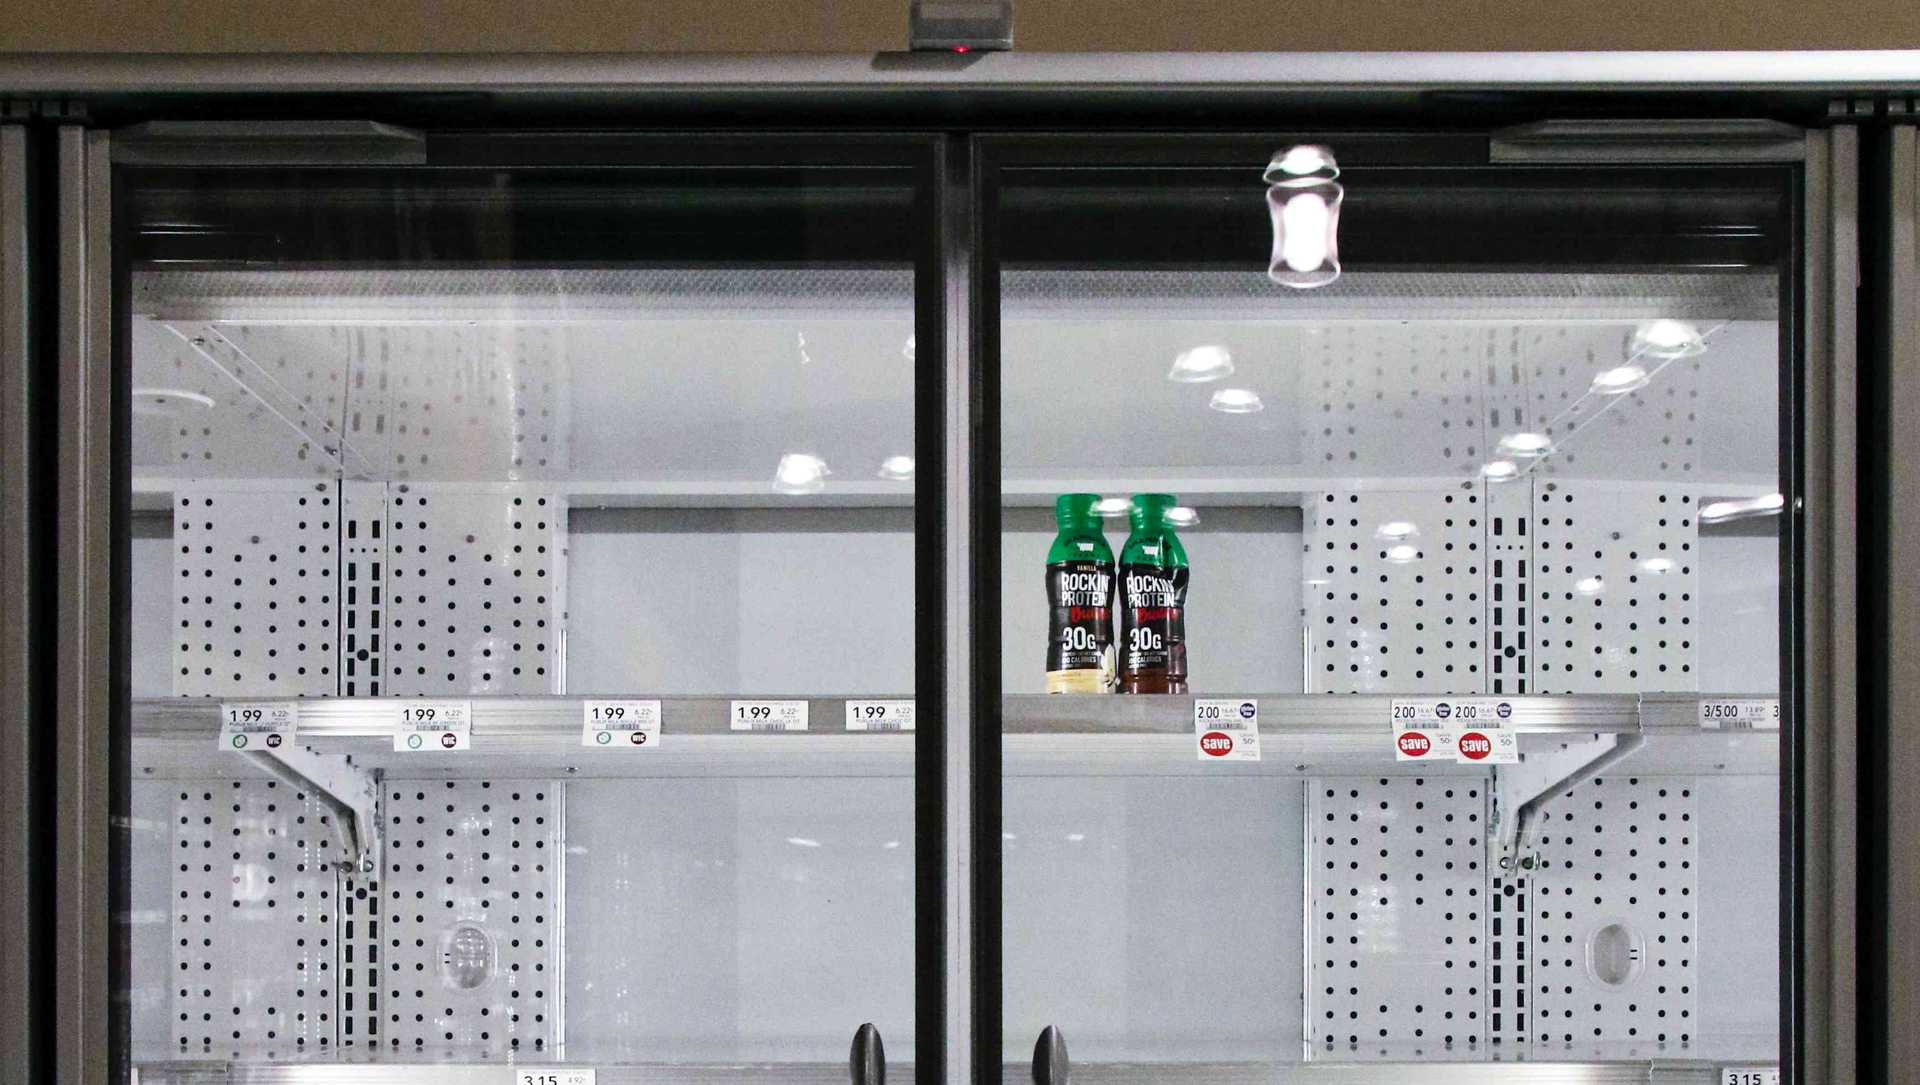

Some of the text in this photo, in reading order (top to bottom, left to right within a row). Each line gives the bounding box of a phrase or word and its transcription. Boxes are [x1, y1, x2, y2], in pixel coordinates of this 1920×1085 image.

[1062, 591, 1107, 608] PROTEIN
[1128, 592, 1175, 608] PROTEIN
[1203, 738, 1230, 749] save
[1400, 738, 1428, 750] save
[1462, 740, 1489, 752] save
